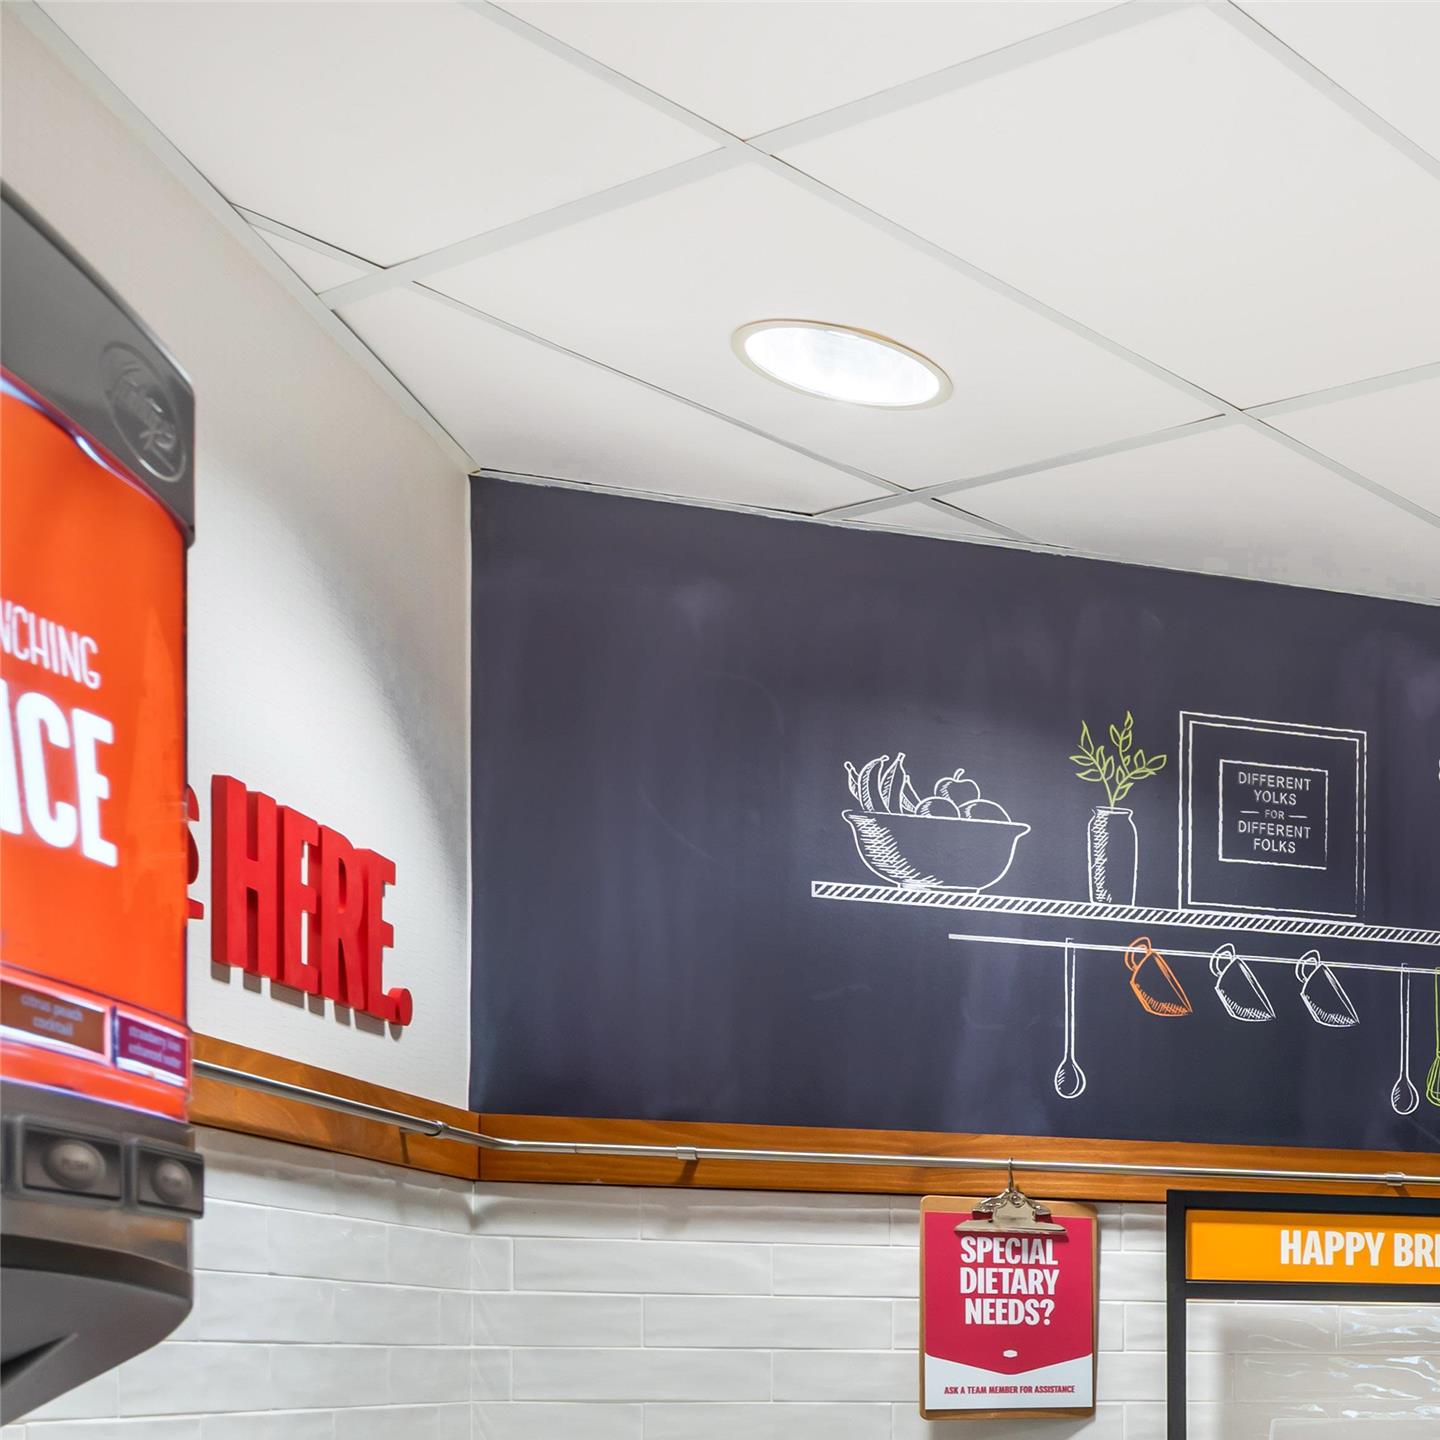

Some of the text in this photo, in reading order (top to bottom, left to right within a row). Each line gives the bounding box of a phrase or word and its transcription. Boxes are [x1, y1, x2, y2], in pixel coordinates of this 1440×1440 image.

[1238, 771, 1311, 791] DIFFERENT
[1254, 789, 1297, 806] YOLKS
[1265, 809, 1285, 820] FOR
[1238, 820, 1311, 839] DIFFERENT
[1253, 838, 1296, 854] FOLKS
[960, 1235, 1059, 1265] SPECIAL
[1280, 1229, 1385, 1267] HAPPY
[959, 1267, 1060, 1295] DIETARY
[964, 1298, 1055, 1326] NEEDS?
[944, 1385, 1075, 1394] ASK A TEAM MEMBER FOR ASSISTANCE
